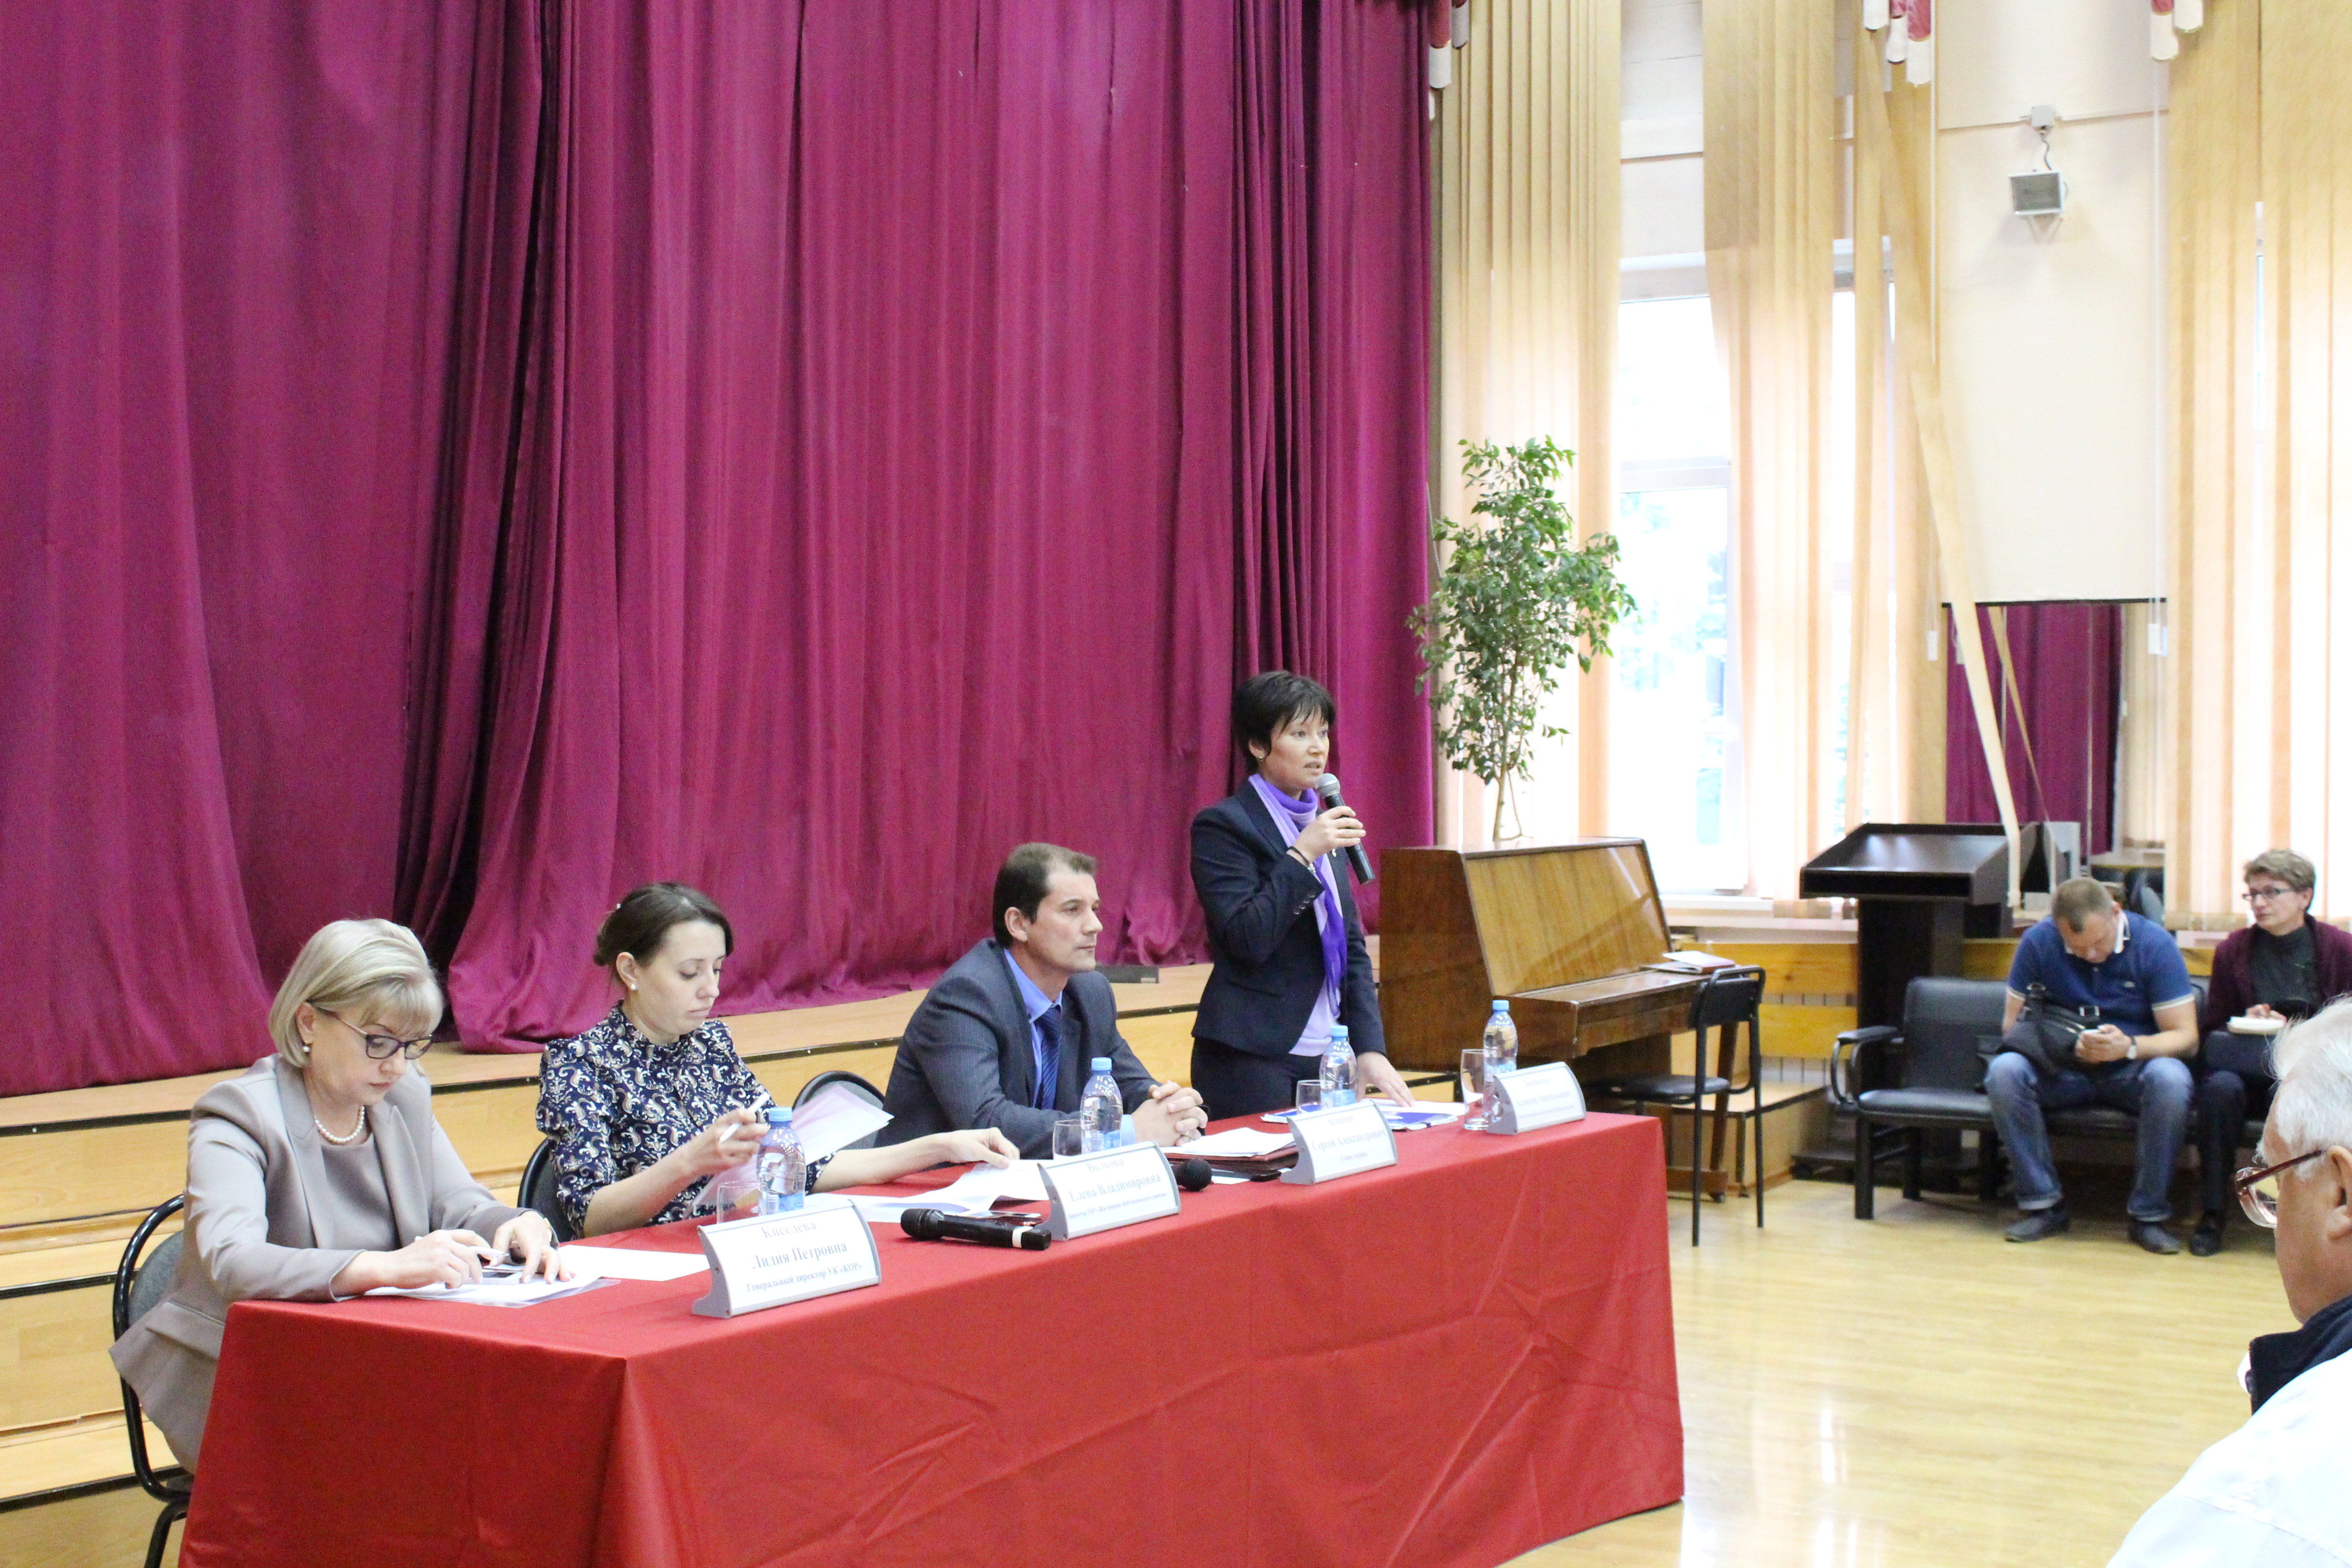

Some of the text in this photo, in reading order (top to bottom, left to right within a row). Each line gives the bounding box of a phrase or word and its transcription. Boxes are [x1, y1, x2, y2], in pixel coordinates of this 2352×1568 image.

[1312, 1139, 1337, 1152] Сергей
[1086, 1159, 1125, 1173] Волкова
[1068, 1174, 1161, 1202] Елена Владимировна
[761, 1222, 817, 1239] Киселева
[752, 1243, 848, 1269] Лидия Петровна
[747, 1262, 862, 1292] Генеральный директор УК «КОР»
